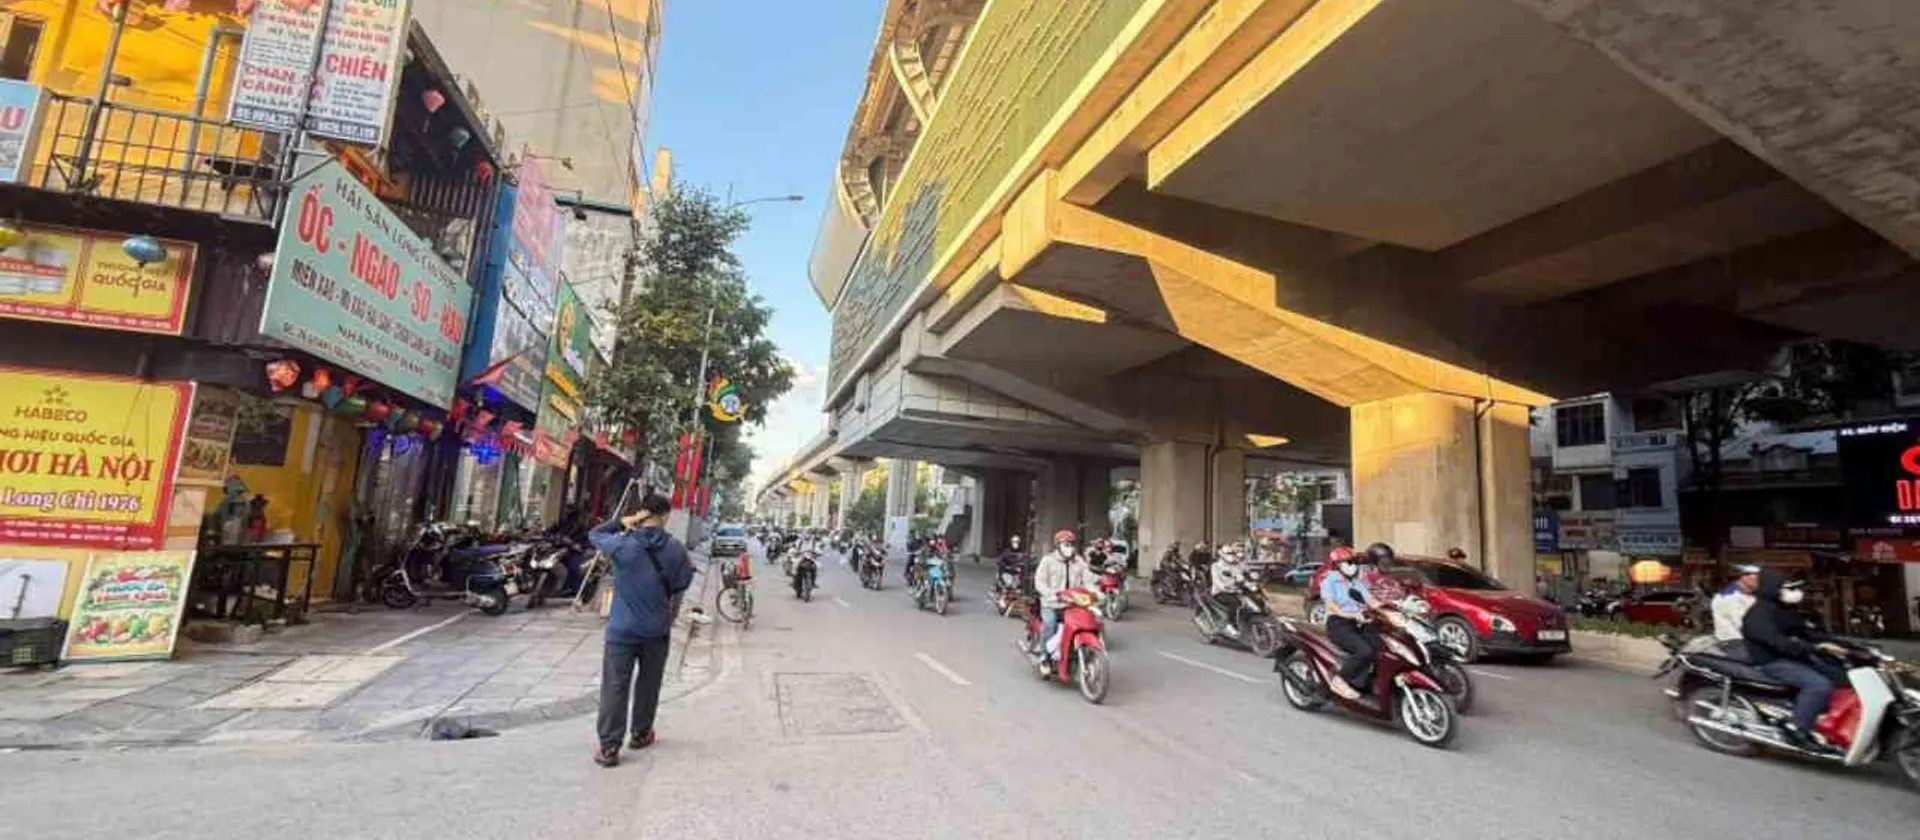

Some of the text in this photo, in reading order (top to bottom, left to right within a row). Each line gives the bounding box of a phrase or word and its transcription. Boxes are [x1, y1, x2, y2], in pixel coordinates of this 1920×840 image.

[298, 184, 333, 253] ỐC
[350, 231, 399, 300] NGAO
[142, 279, 166, 292] GIA
[14, 405, 88, 423] HABECO
[62, 430, 107, 445] QUỐC
[109, 435, 135, 448] GIA
[48, 447, 90, 477] HÀ
[98, 452, 156, 486] NỘI
[5, 487, 55, 512] Long
[99, 494, 141, 513] 1976
